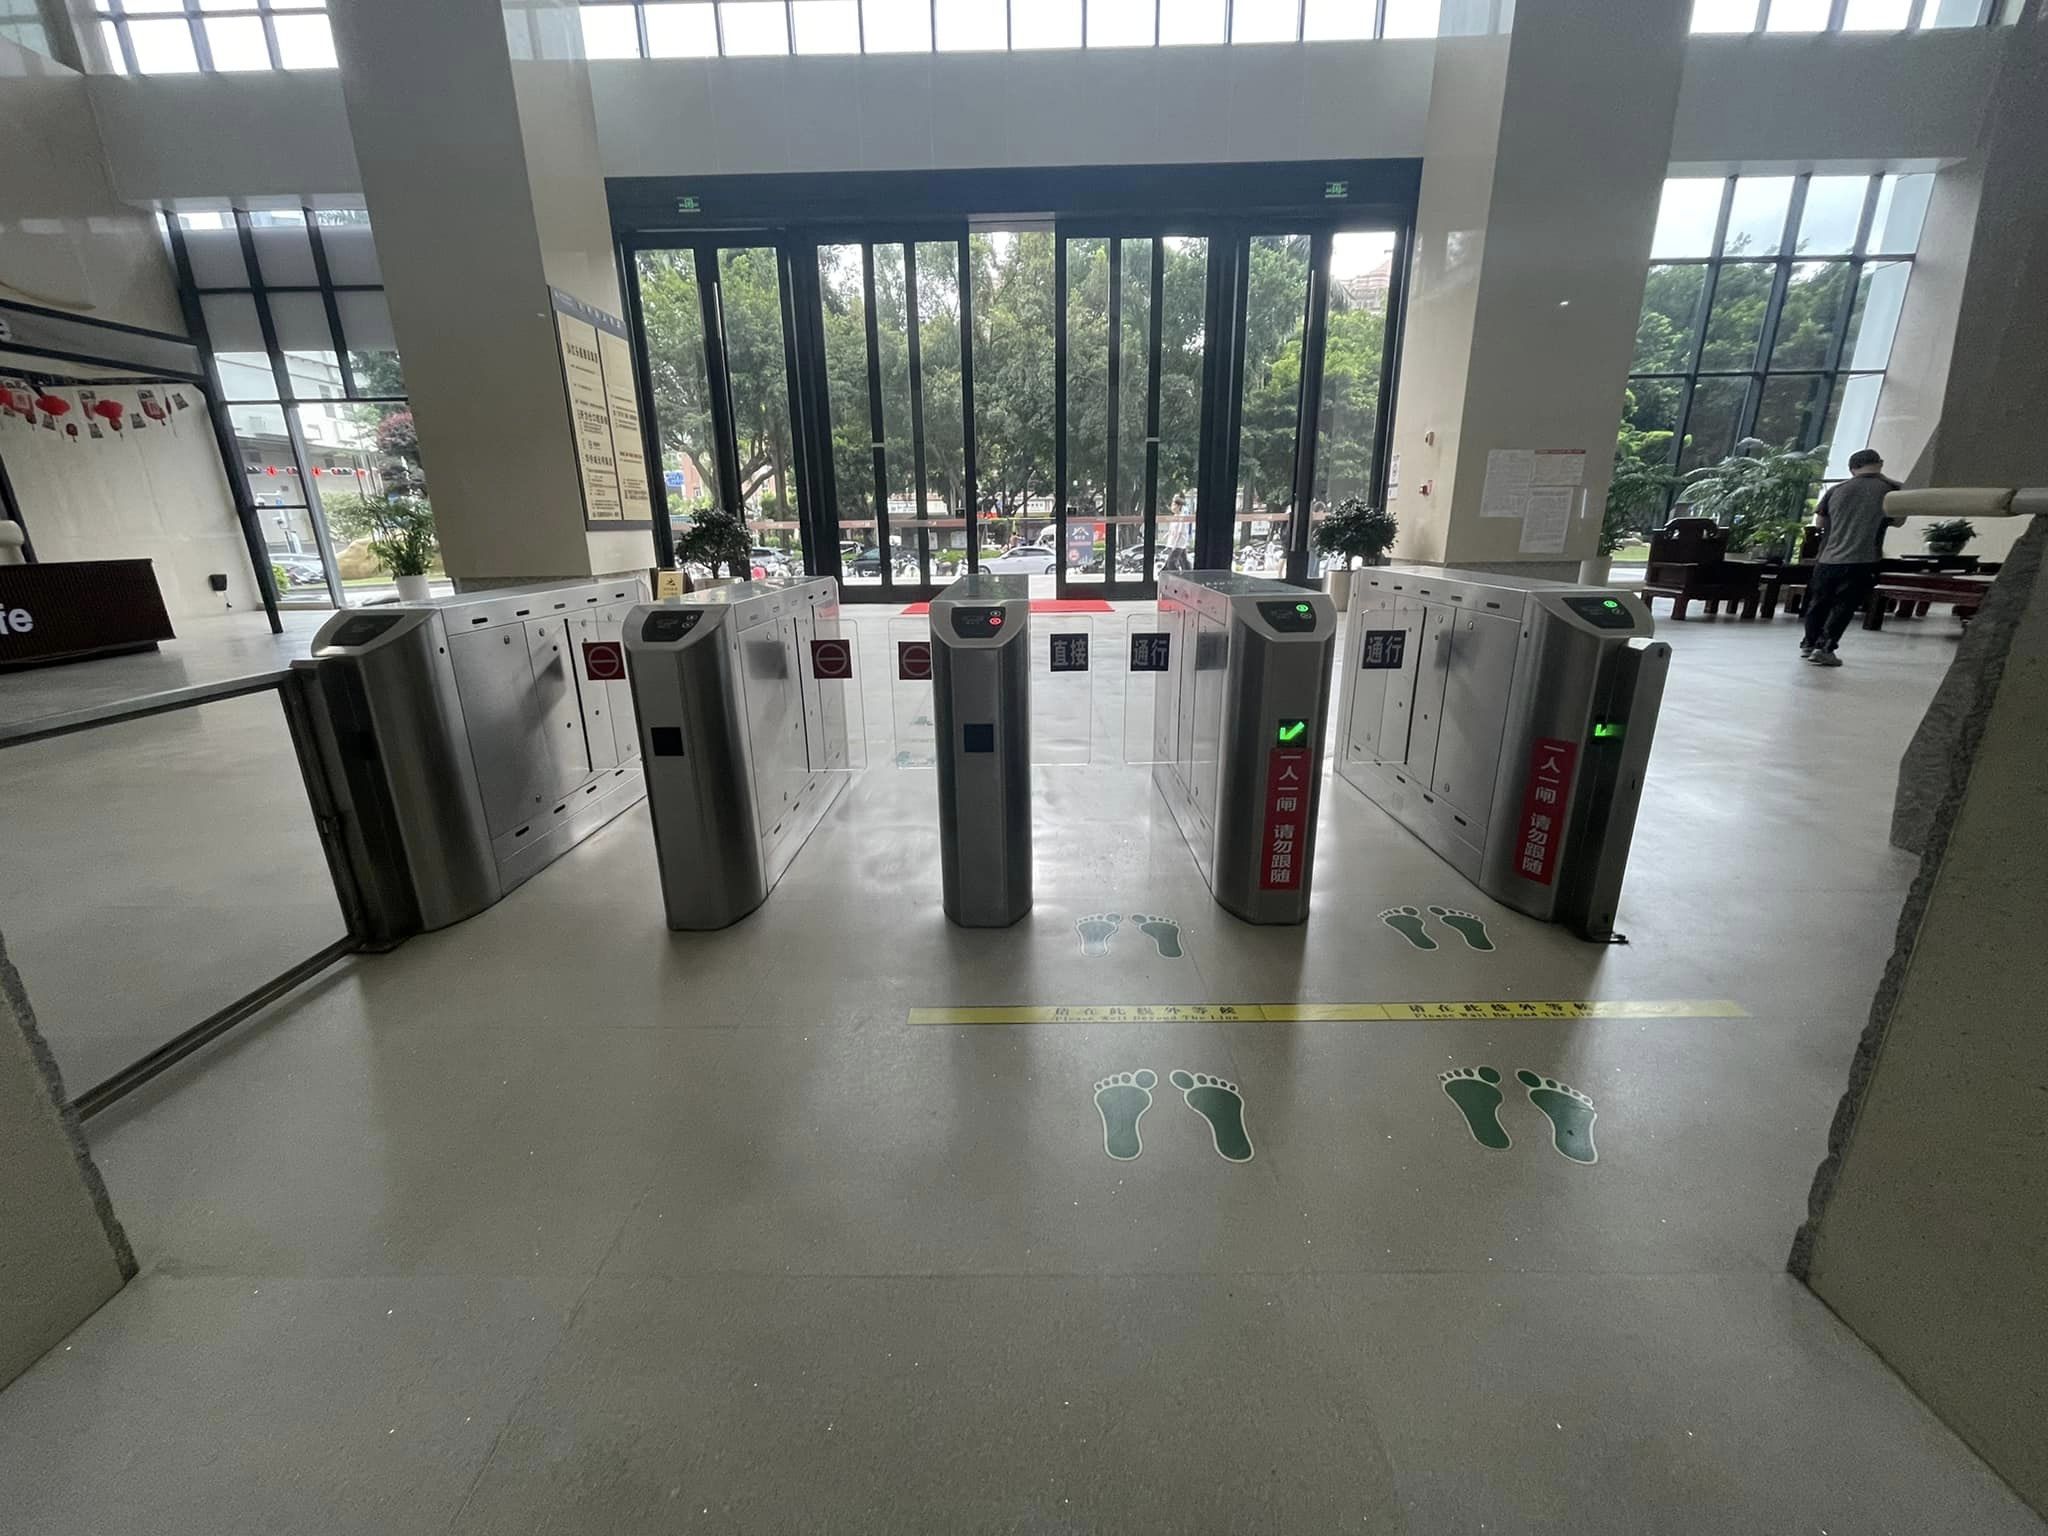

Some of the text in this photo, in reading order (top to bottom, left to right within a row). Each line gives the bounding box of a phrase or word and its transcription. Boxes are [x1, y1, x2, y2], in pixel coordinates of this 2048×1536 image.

[1053, 638, 1087, 667] 直接
[1133, 638, 1168, 667] 通行
[1366, 635, 1402, 664] 通行
